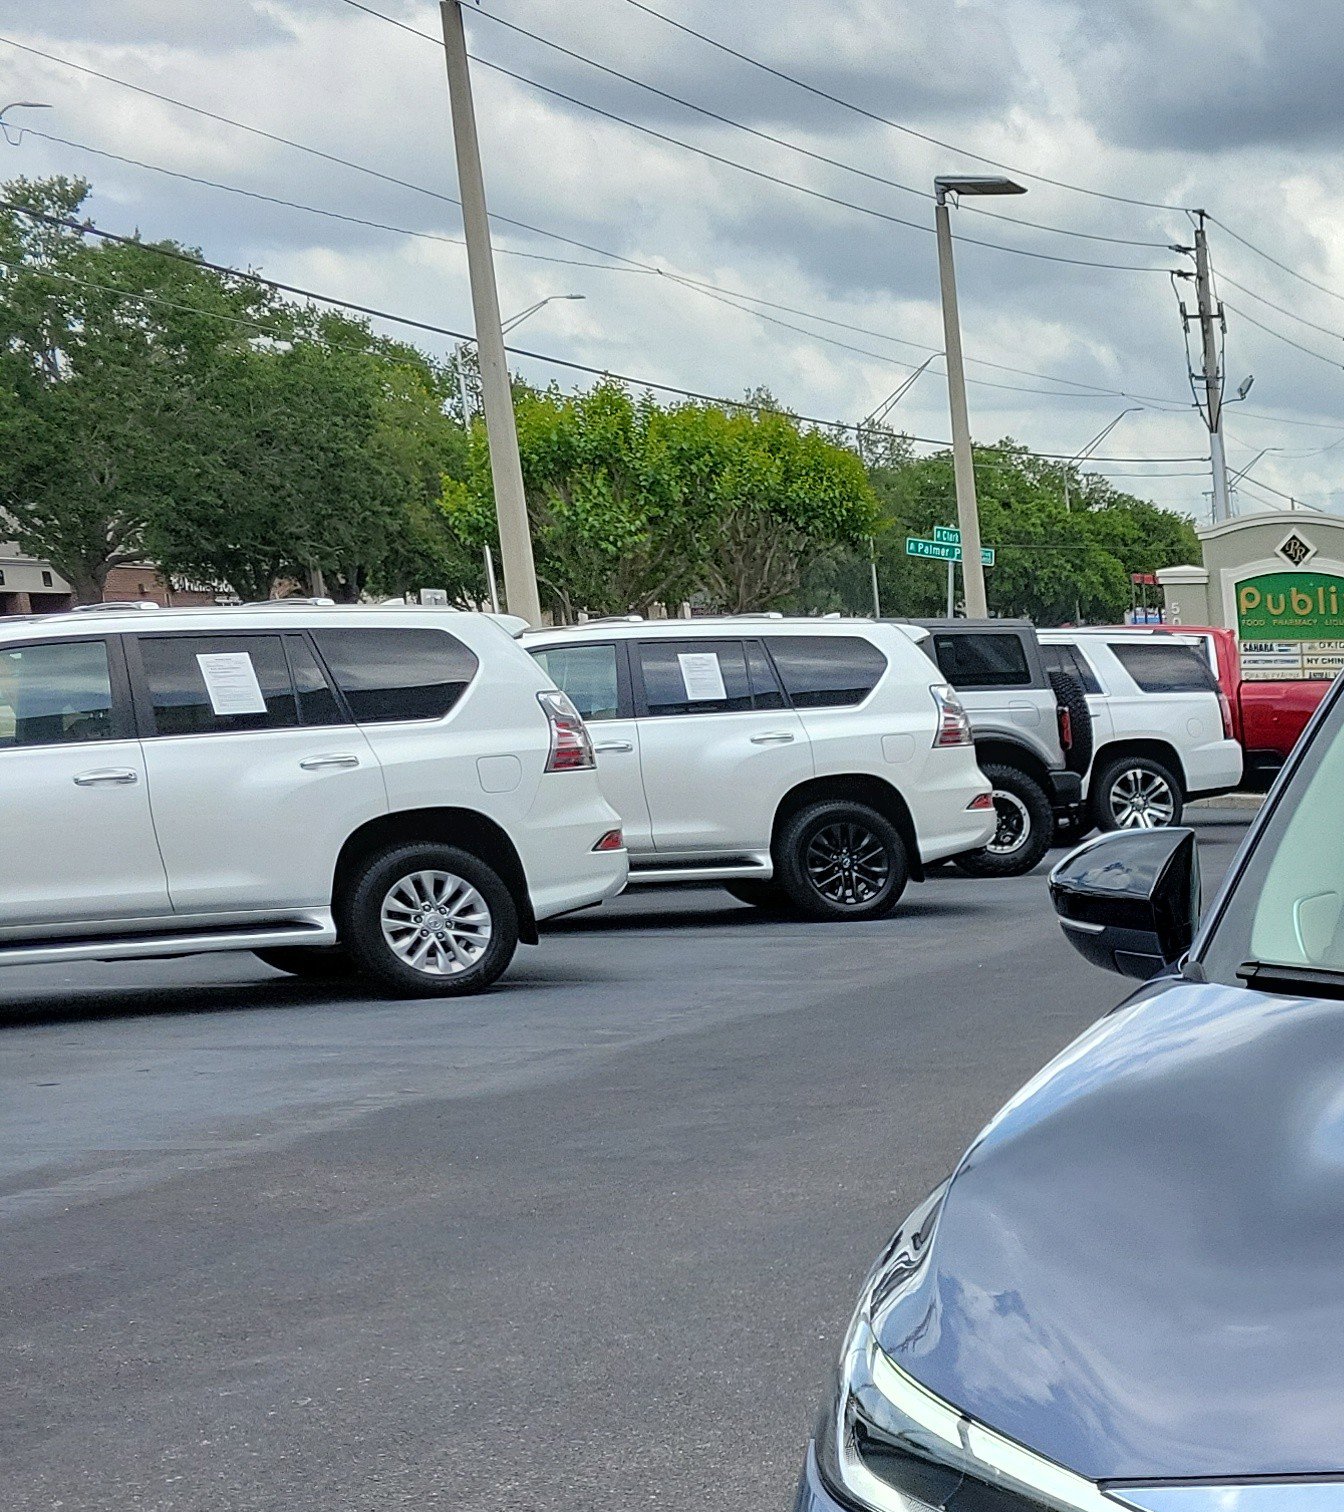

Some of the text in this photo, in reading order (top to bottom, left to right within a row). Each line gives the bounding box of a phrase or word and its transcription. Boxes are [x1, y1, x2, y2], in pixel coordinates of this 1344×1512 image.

[917, 543, 949, 556] Palmer
[1242, 618, 1266, 626] FOOD
[1272, 618, 1318, 626] PHARMACY
